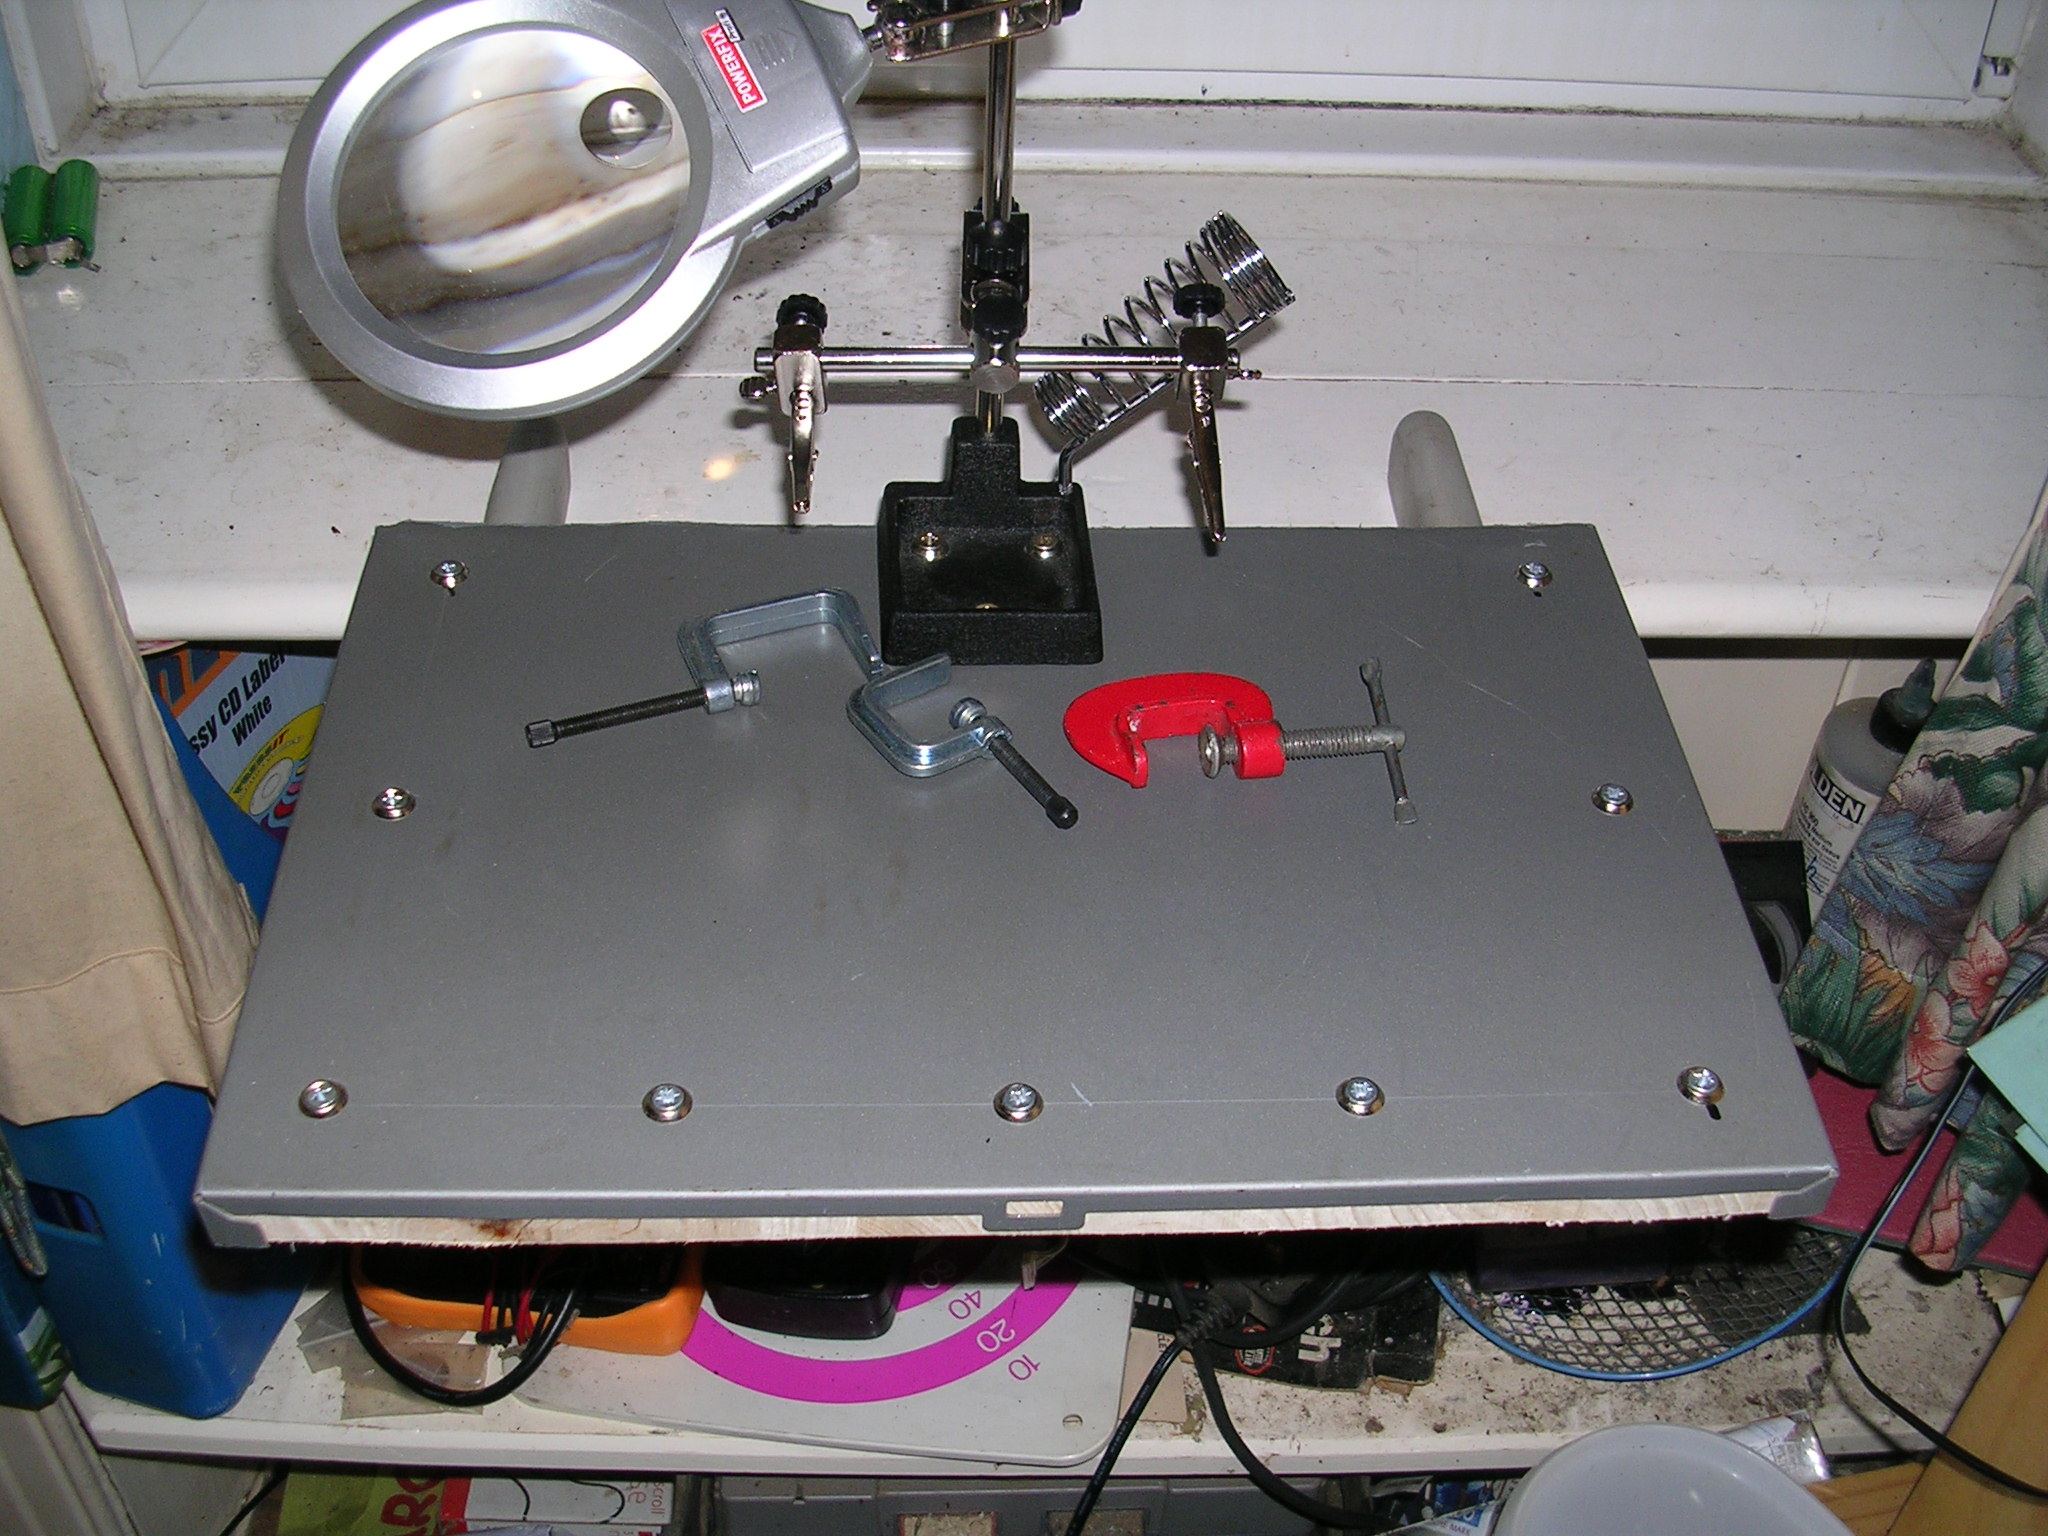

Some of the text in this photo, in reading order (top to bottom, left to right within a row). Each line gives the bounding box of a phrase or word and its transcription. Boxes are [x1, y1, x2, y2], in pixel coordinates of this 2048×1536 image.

[708, 27, 758, 104] POWERFIX
[218, 686, 241, 726] CD
[232, 696, 273, 747] White
[948, 1290, 982, 1320] 40
[976, 1318, 1016, 1353] 20
[1008, 1354, 1041, 1382] 10
